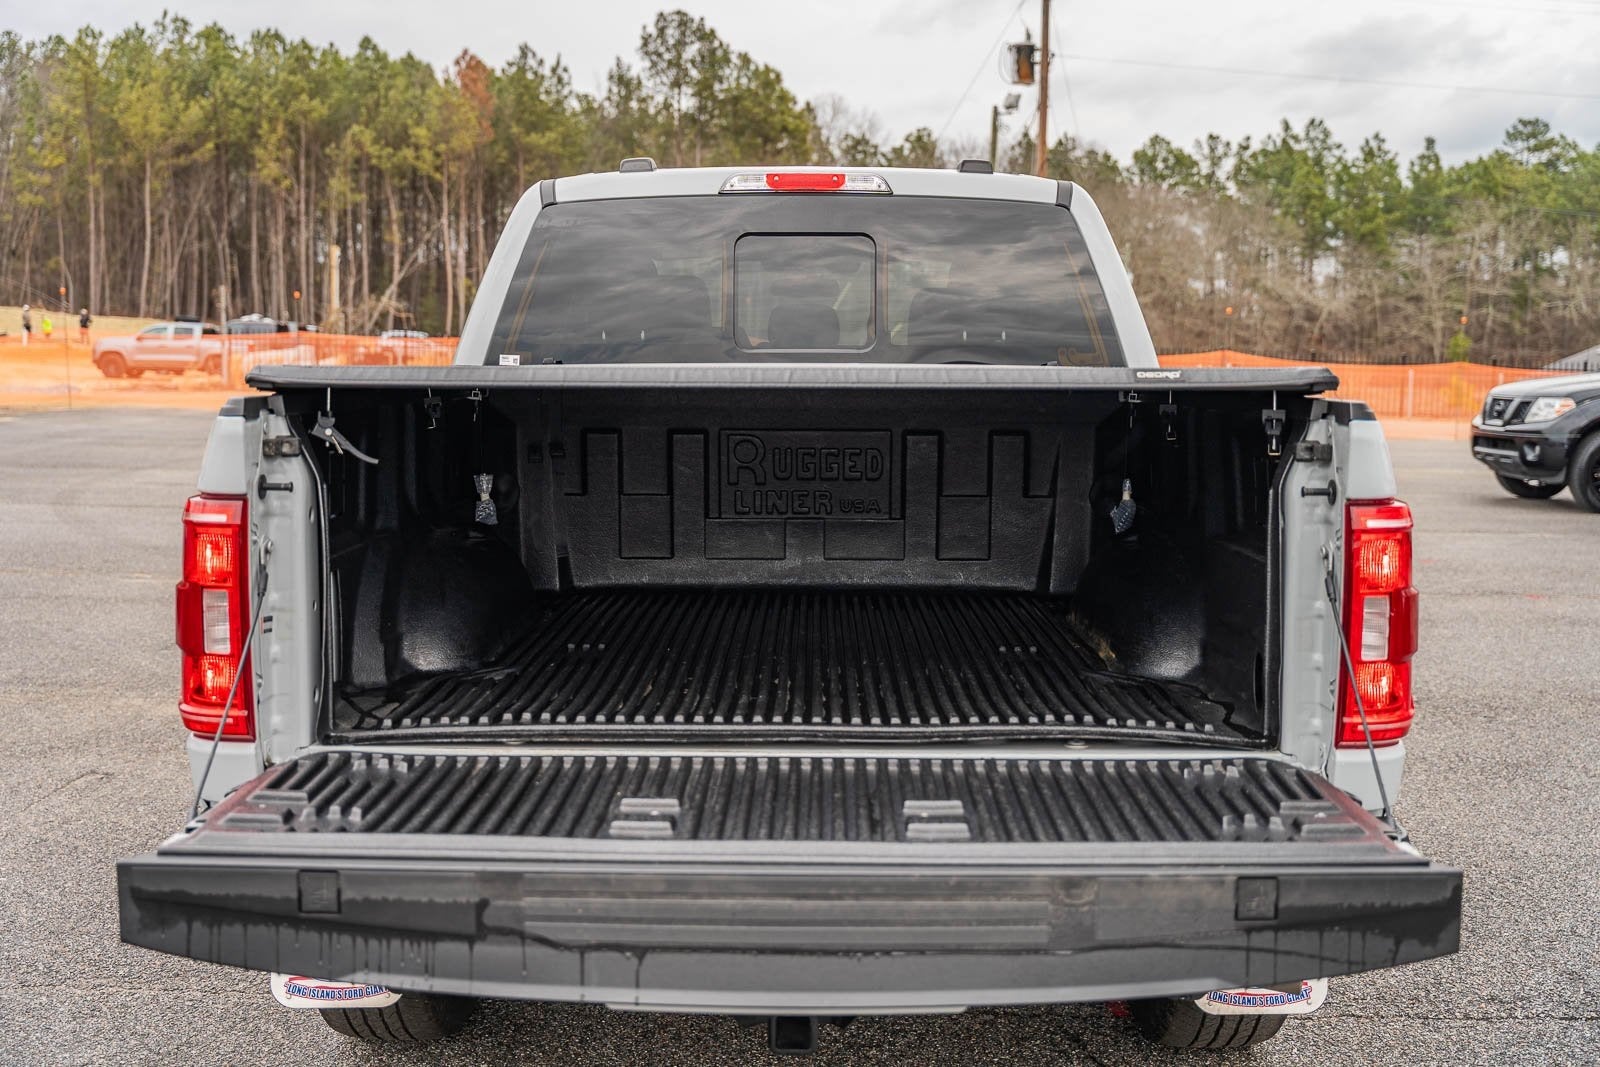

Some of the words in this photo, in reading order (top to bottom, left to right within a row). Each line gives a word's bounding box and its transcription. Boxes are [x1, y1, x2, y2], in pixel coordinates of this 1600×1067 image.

[727, 434, 883, 486] RUGGED
[734, 489, 833, 515] LINER
[839, 498, 881, 514] USA
[308, 987, 343, 1000] ISLAND'S
[344, 988, 363, 999] FORD
[1208, 991, 1228, 1003] LONG
[1229, 994, 1264, 1007] ISLAND'S
[1265, 994, 1285, 1006] FORD
